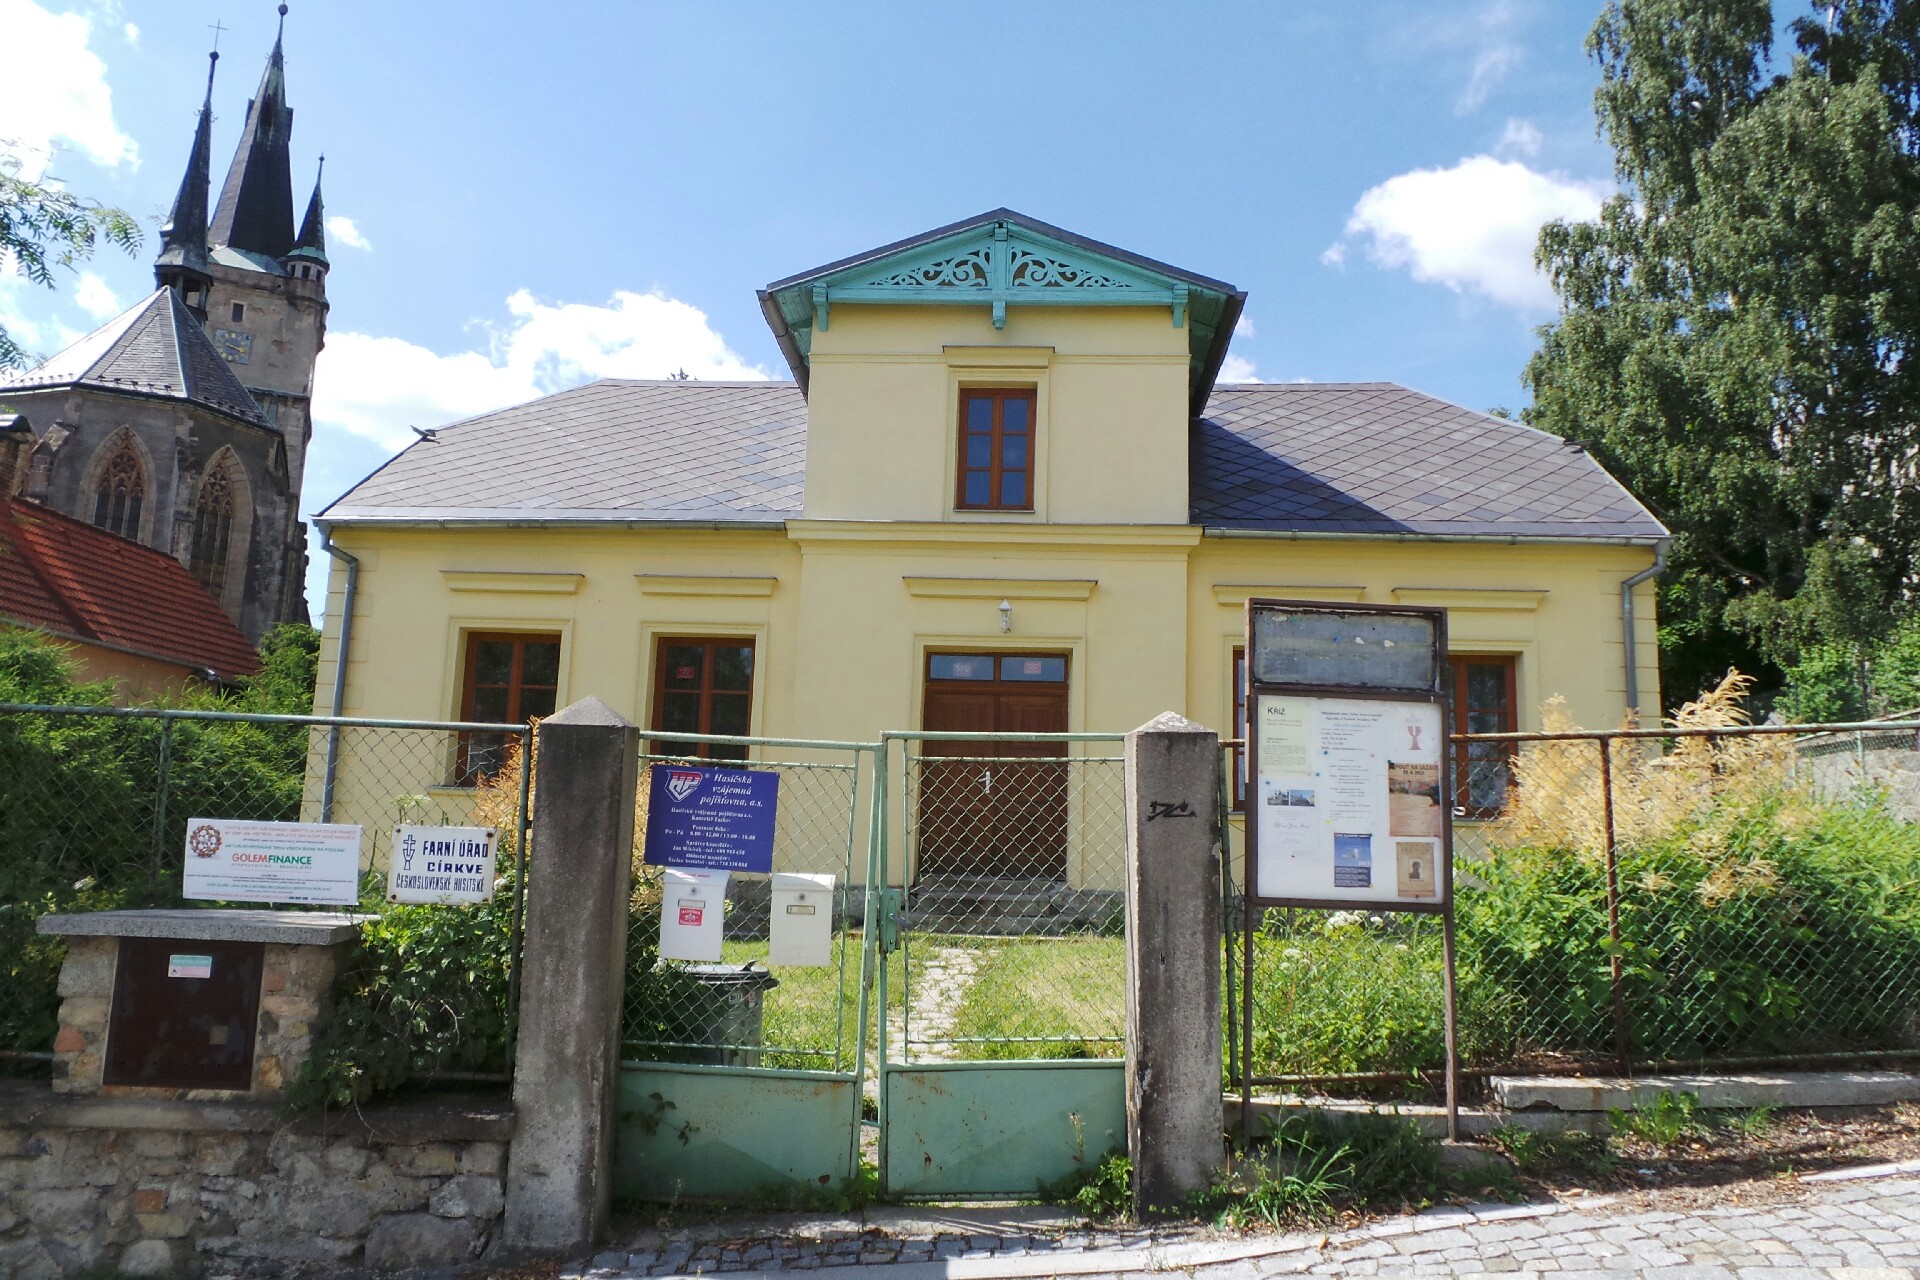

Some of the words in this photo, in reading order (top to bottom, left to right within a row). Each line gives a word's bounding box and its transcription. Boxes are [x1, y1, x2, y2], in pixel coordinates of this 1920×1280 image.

[713, 773, 753, 784] Hasičská
[712, 785, 752, 795] vzájemná
[699, 795, 747, 807] pojišťovna,
[749, 799, 763, 807] a.s.
[422, 839, 456, 857] FARNÍ
[458, 839, 489, 858] ÚŘAD
[427, 860, 484, 874] CÍRKVE
[395, 872, 452, 891] ČESKOSLOVENSKÉ
[453, 877, 485, 893] HUSITSKÉ
